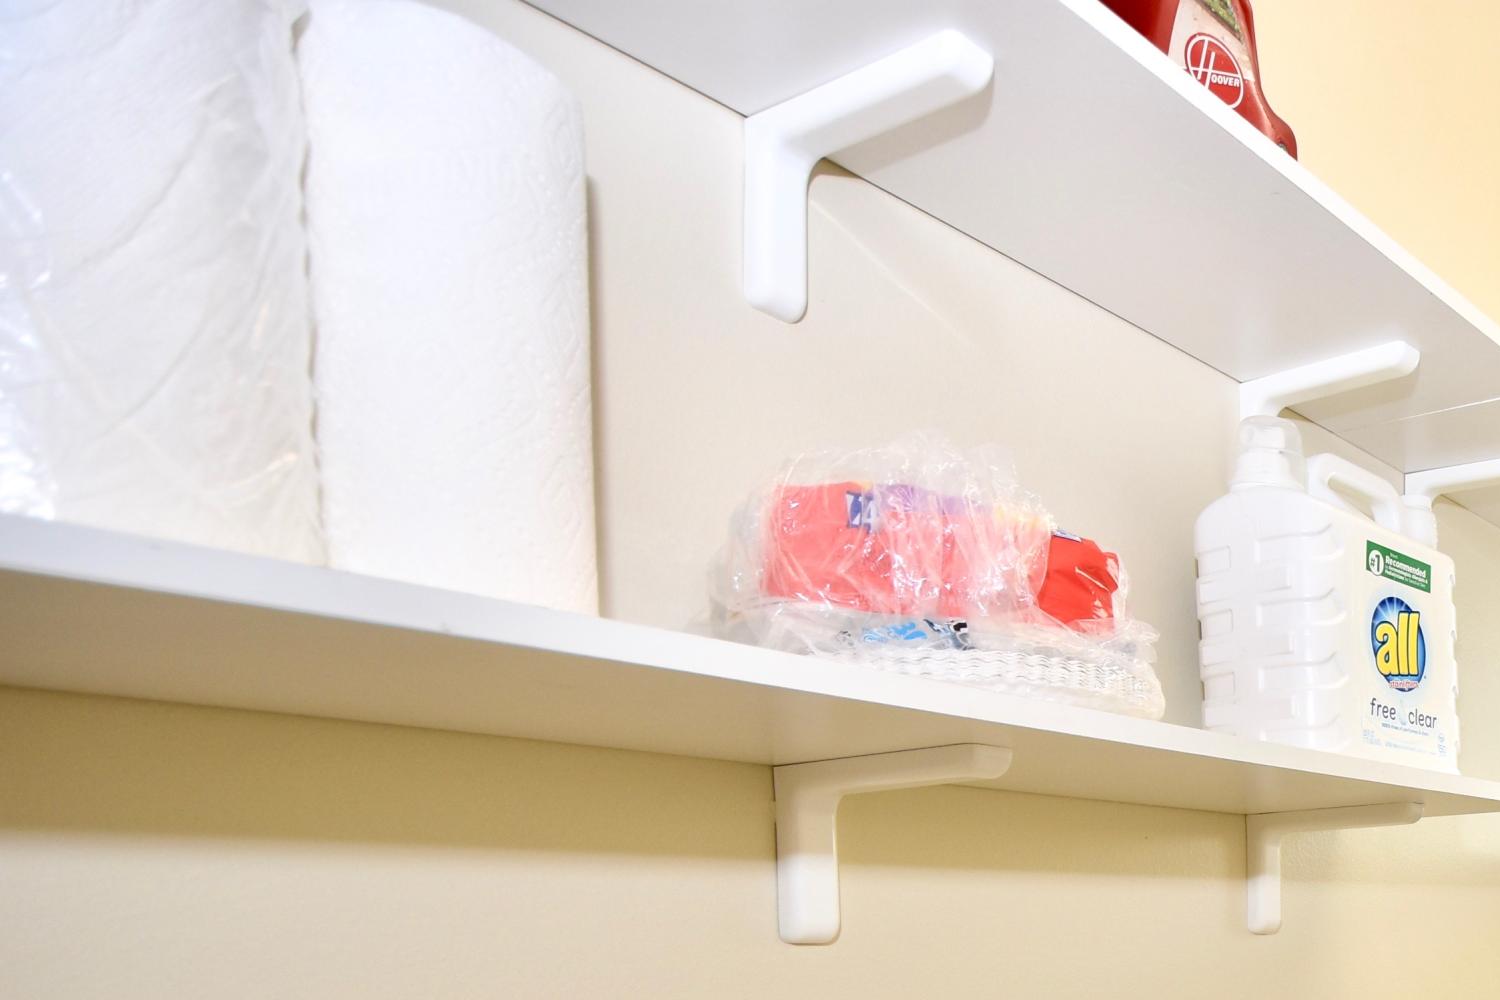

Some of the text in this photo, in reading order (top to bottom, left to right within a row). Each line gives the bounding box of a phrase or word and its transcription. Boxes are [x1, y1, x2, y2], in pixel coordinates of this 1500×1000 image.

[1370, 553, 1380, 573] #1
[1385, 555, 1427, 579] Recommended
[1375, 610, 1420, 677] all
[1369, 697, 1438, 729] free clear
